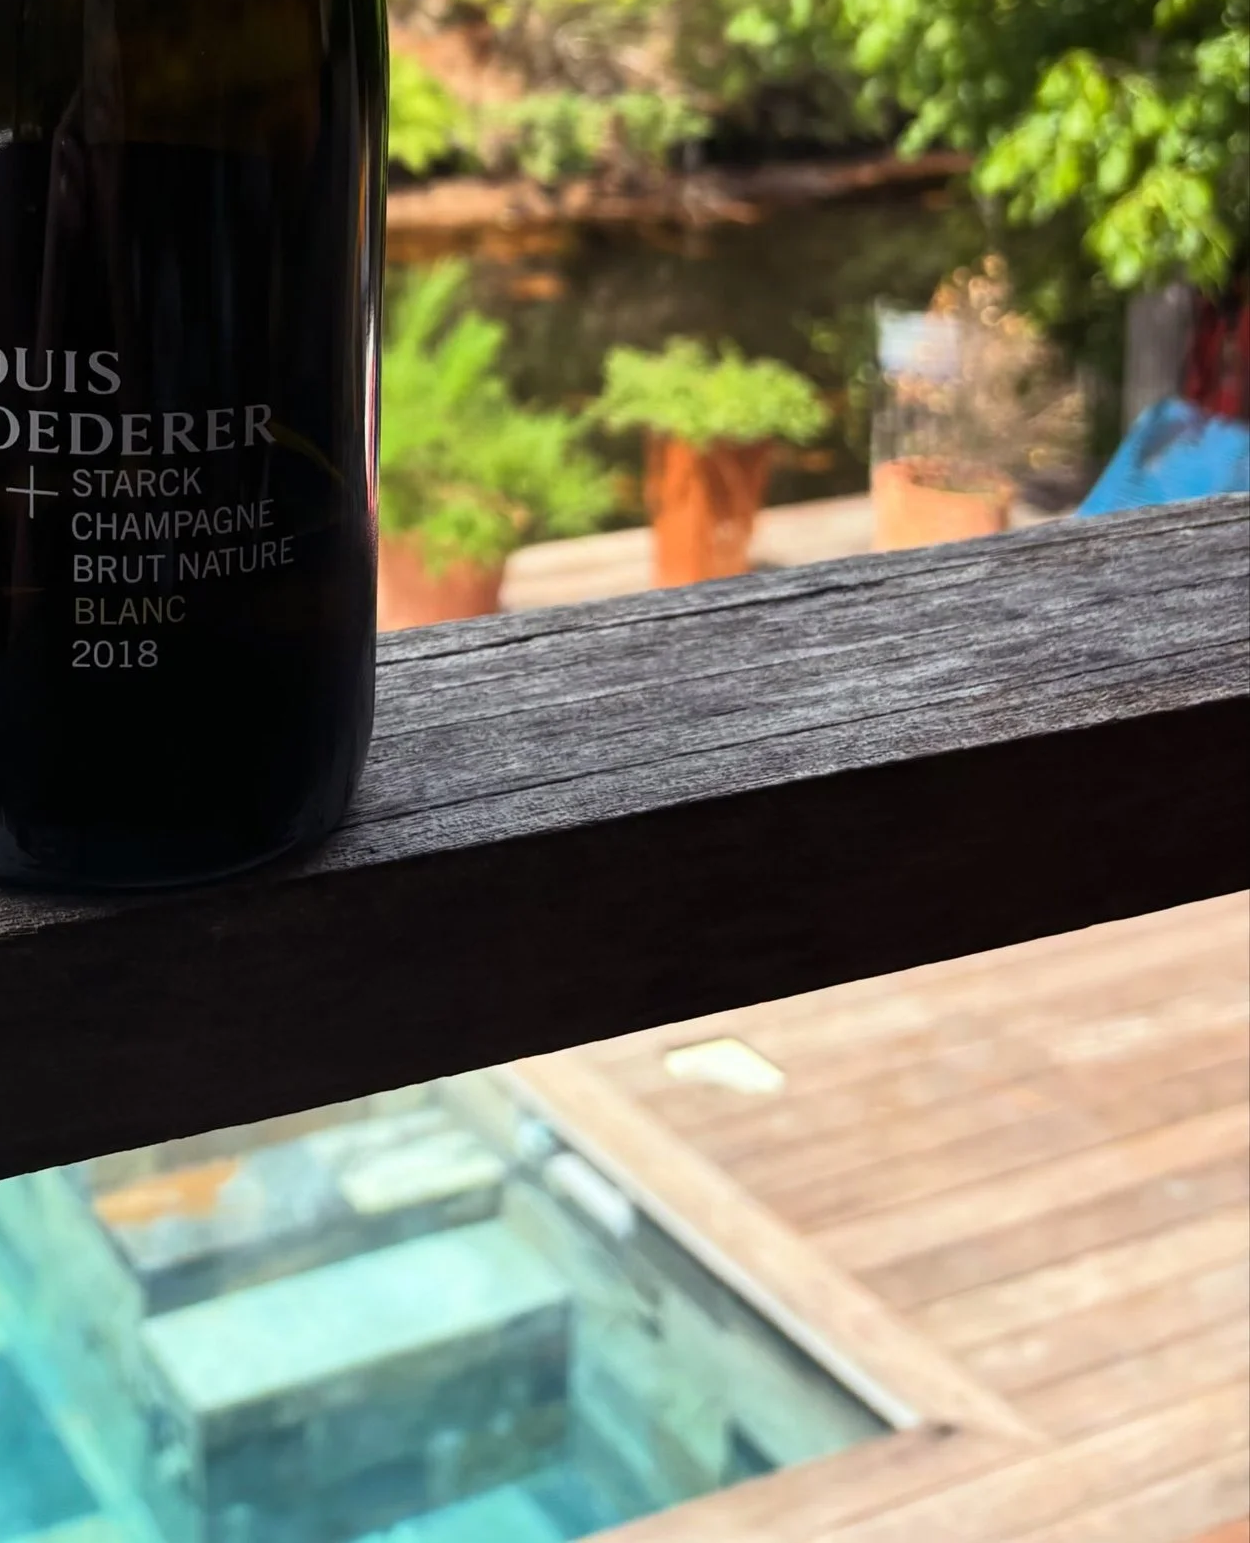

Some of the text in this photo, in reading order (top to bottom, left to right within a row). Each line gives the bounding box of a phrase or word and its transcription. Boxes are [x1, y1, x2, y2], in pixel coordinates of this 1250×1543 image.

[71, 467, 203, 498] STARCK
[71, 499, 275, 541] CHAMPAGNE
[73, 535, 295, 584] BRUT NATURE
[75, 595, 186, 625] BLANC
[71, 639, 159, 669] 2018
